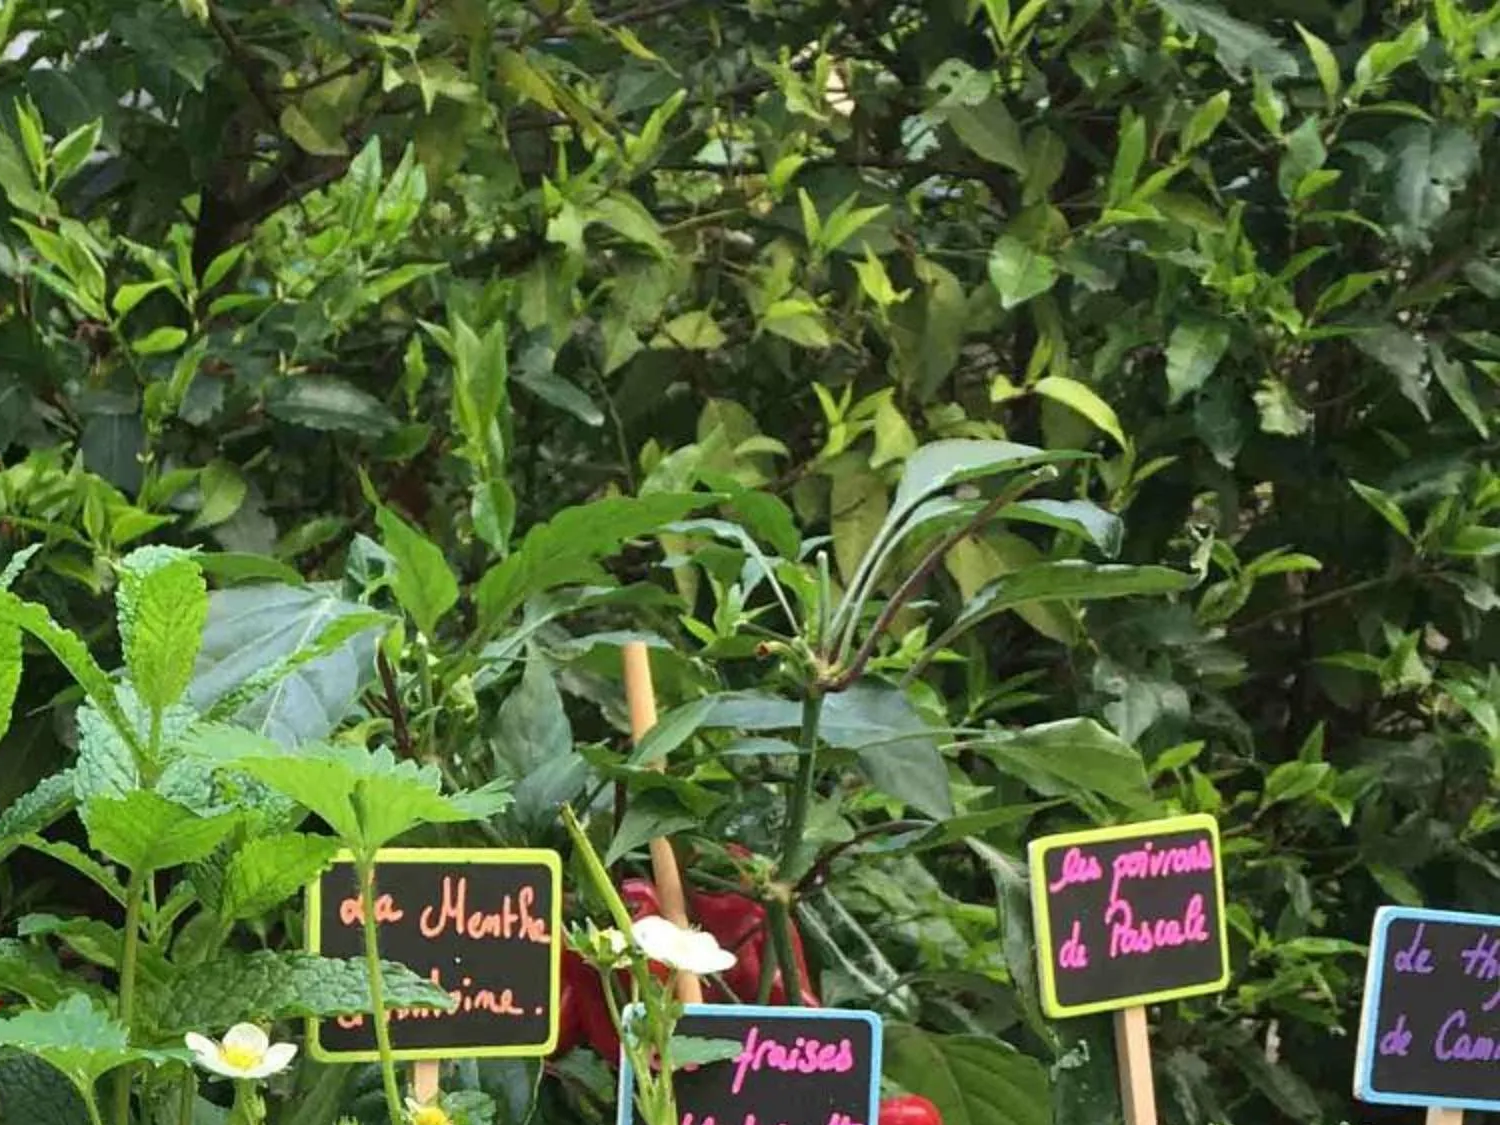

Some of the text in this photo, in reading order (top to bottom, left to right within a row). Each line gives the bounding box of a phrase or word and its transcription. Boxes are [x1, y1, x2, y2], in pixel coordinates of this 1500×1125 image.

[1108, 839, 1213, 904] poivrons
[419, 876, 552, 945] Menthe
[1059, 893, 1210, 968] de Pascale
[730, 1026, 854, 1094] fraises
[1379, 1013, 1413, 1057] de
